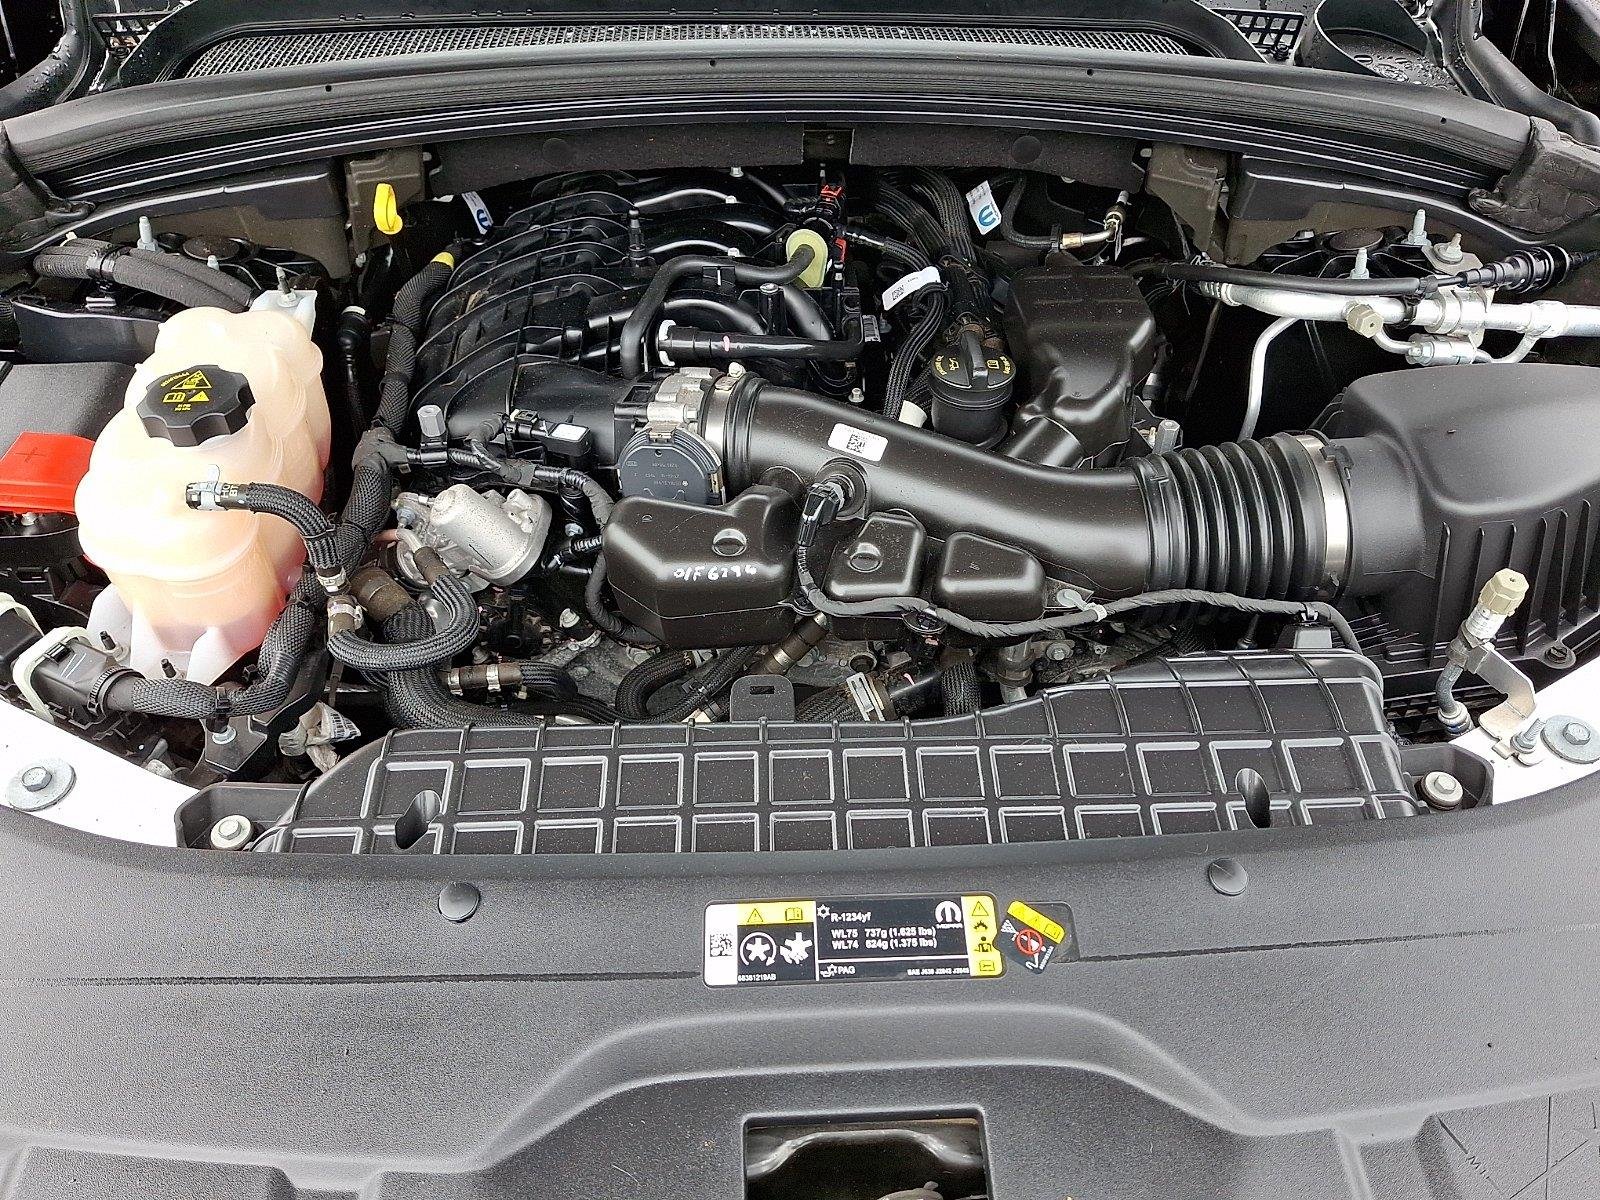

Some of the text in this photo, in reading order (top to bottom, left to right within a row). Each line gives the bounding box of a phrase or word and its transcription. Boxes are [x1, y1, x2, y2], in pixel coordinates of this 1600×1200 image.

[830, 911, 872, 923] R-1234yf
[830, 928, 859, 939] WL75
[864, 927, 888, 939] 737g
[831, 939, 860, 950] WL74
[889, 938, 918, 950] (1.375
[837, 965, 856, 975] PAG
